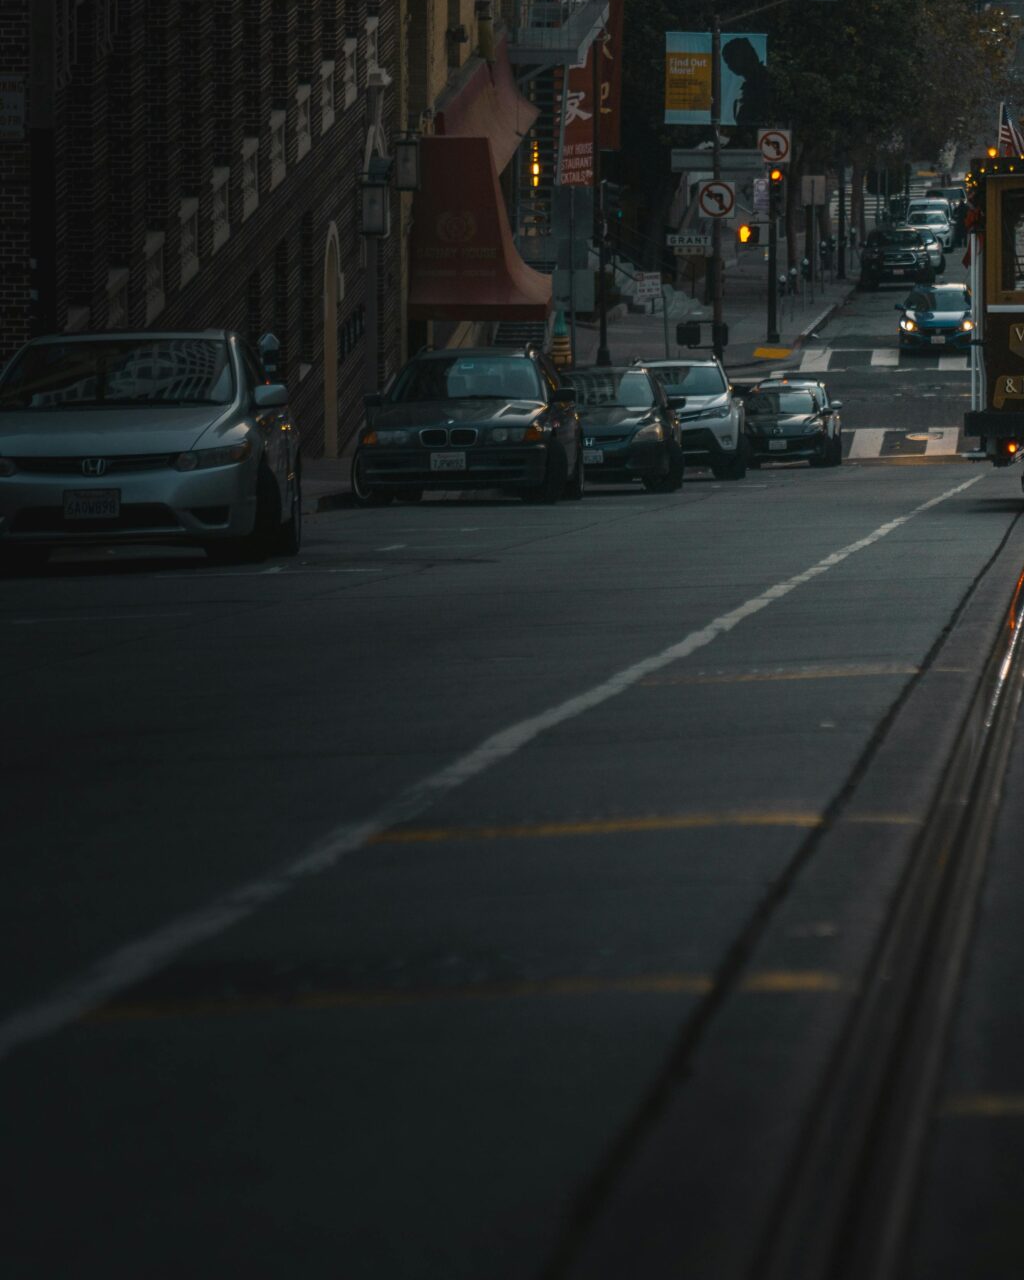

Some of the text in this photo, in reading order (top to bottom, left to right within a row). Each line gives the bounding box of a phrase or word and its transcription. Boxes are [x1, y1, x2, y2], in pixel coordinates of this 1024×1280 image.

[669, 57, 707, 67] Find Out
[670, 236, 709, 244] GRANT
[1005, 377, 1017, 394] &
